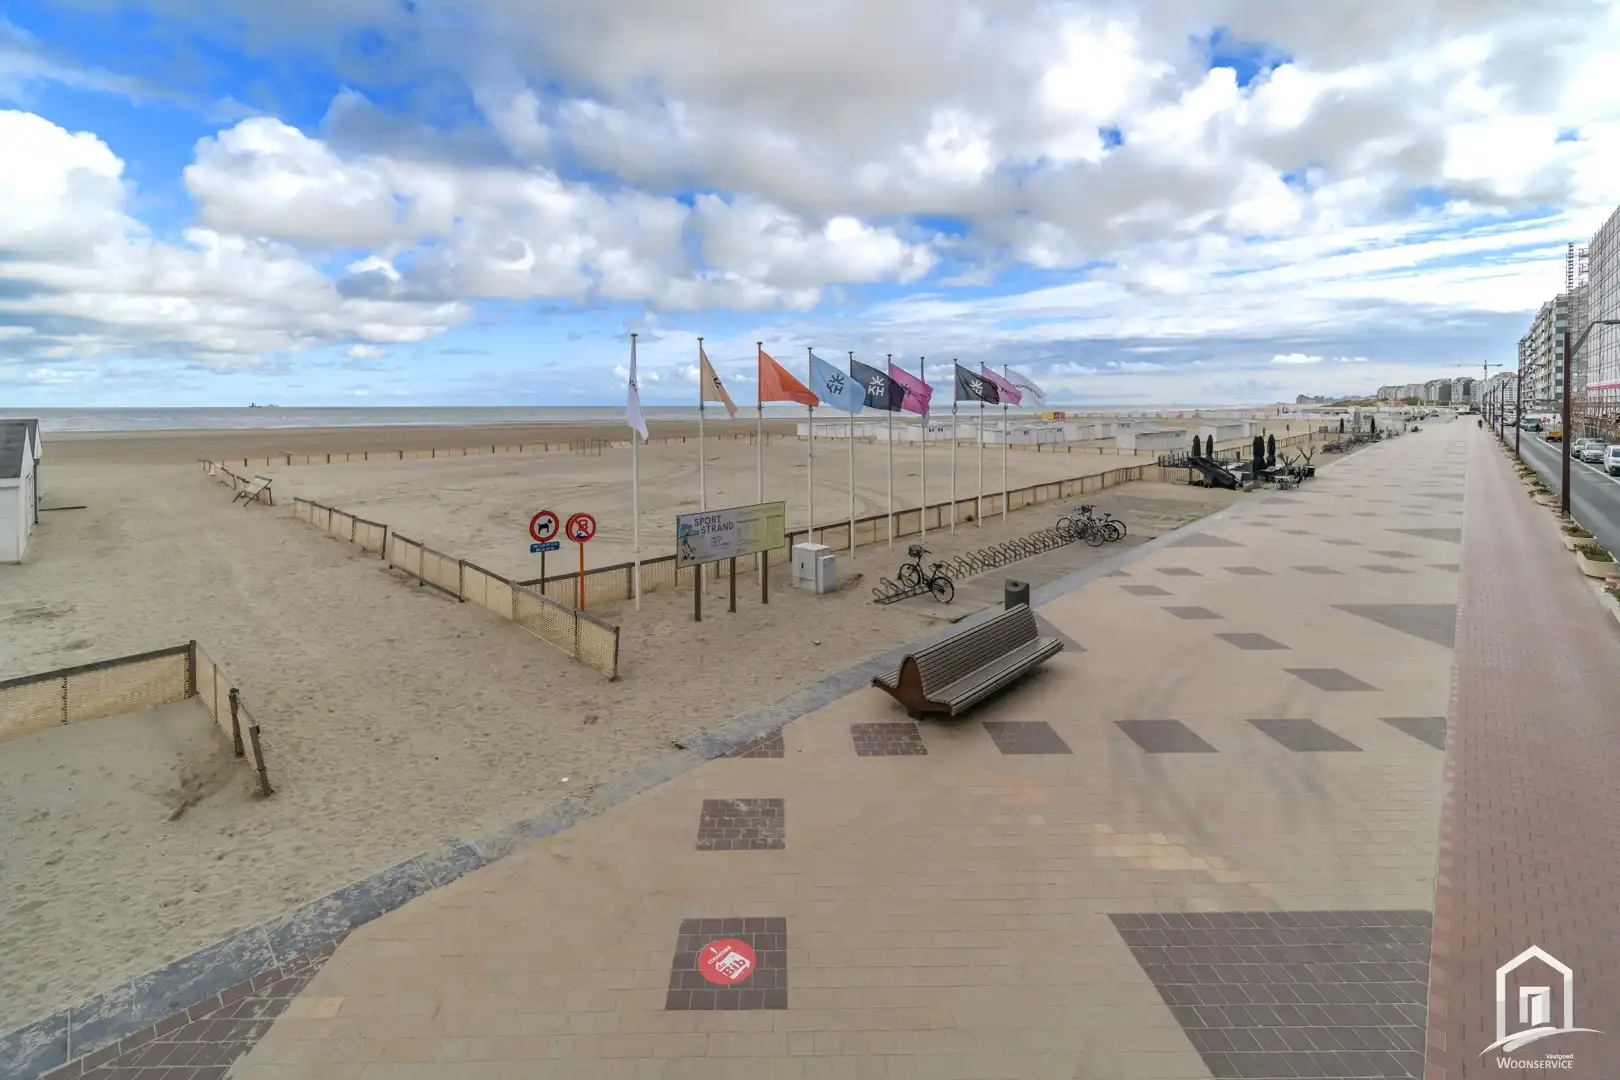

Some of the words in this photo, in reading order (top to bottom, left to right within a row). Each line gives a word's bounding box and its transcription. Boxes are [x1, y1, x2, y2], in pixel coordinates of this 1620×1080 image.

[827, 383, 843, 395] KH
[867, 385, 884, 396] KH
[694, 515, 721, 527] SPORT
[701, 521, 734, 534] STRAND
[723, 959, 746, 976] Bib
